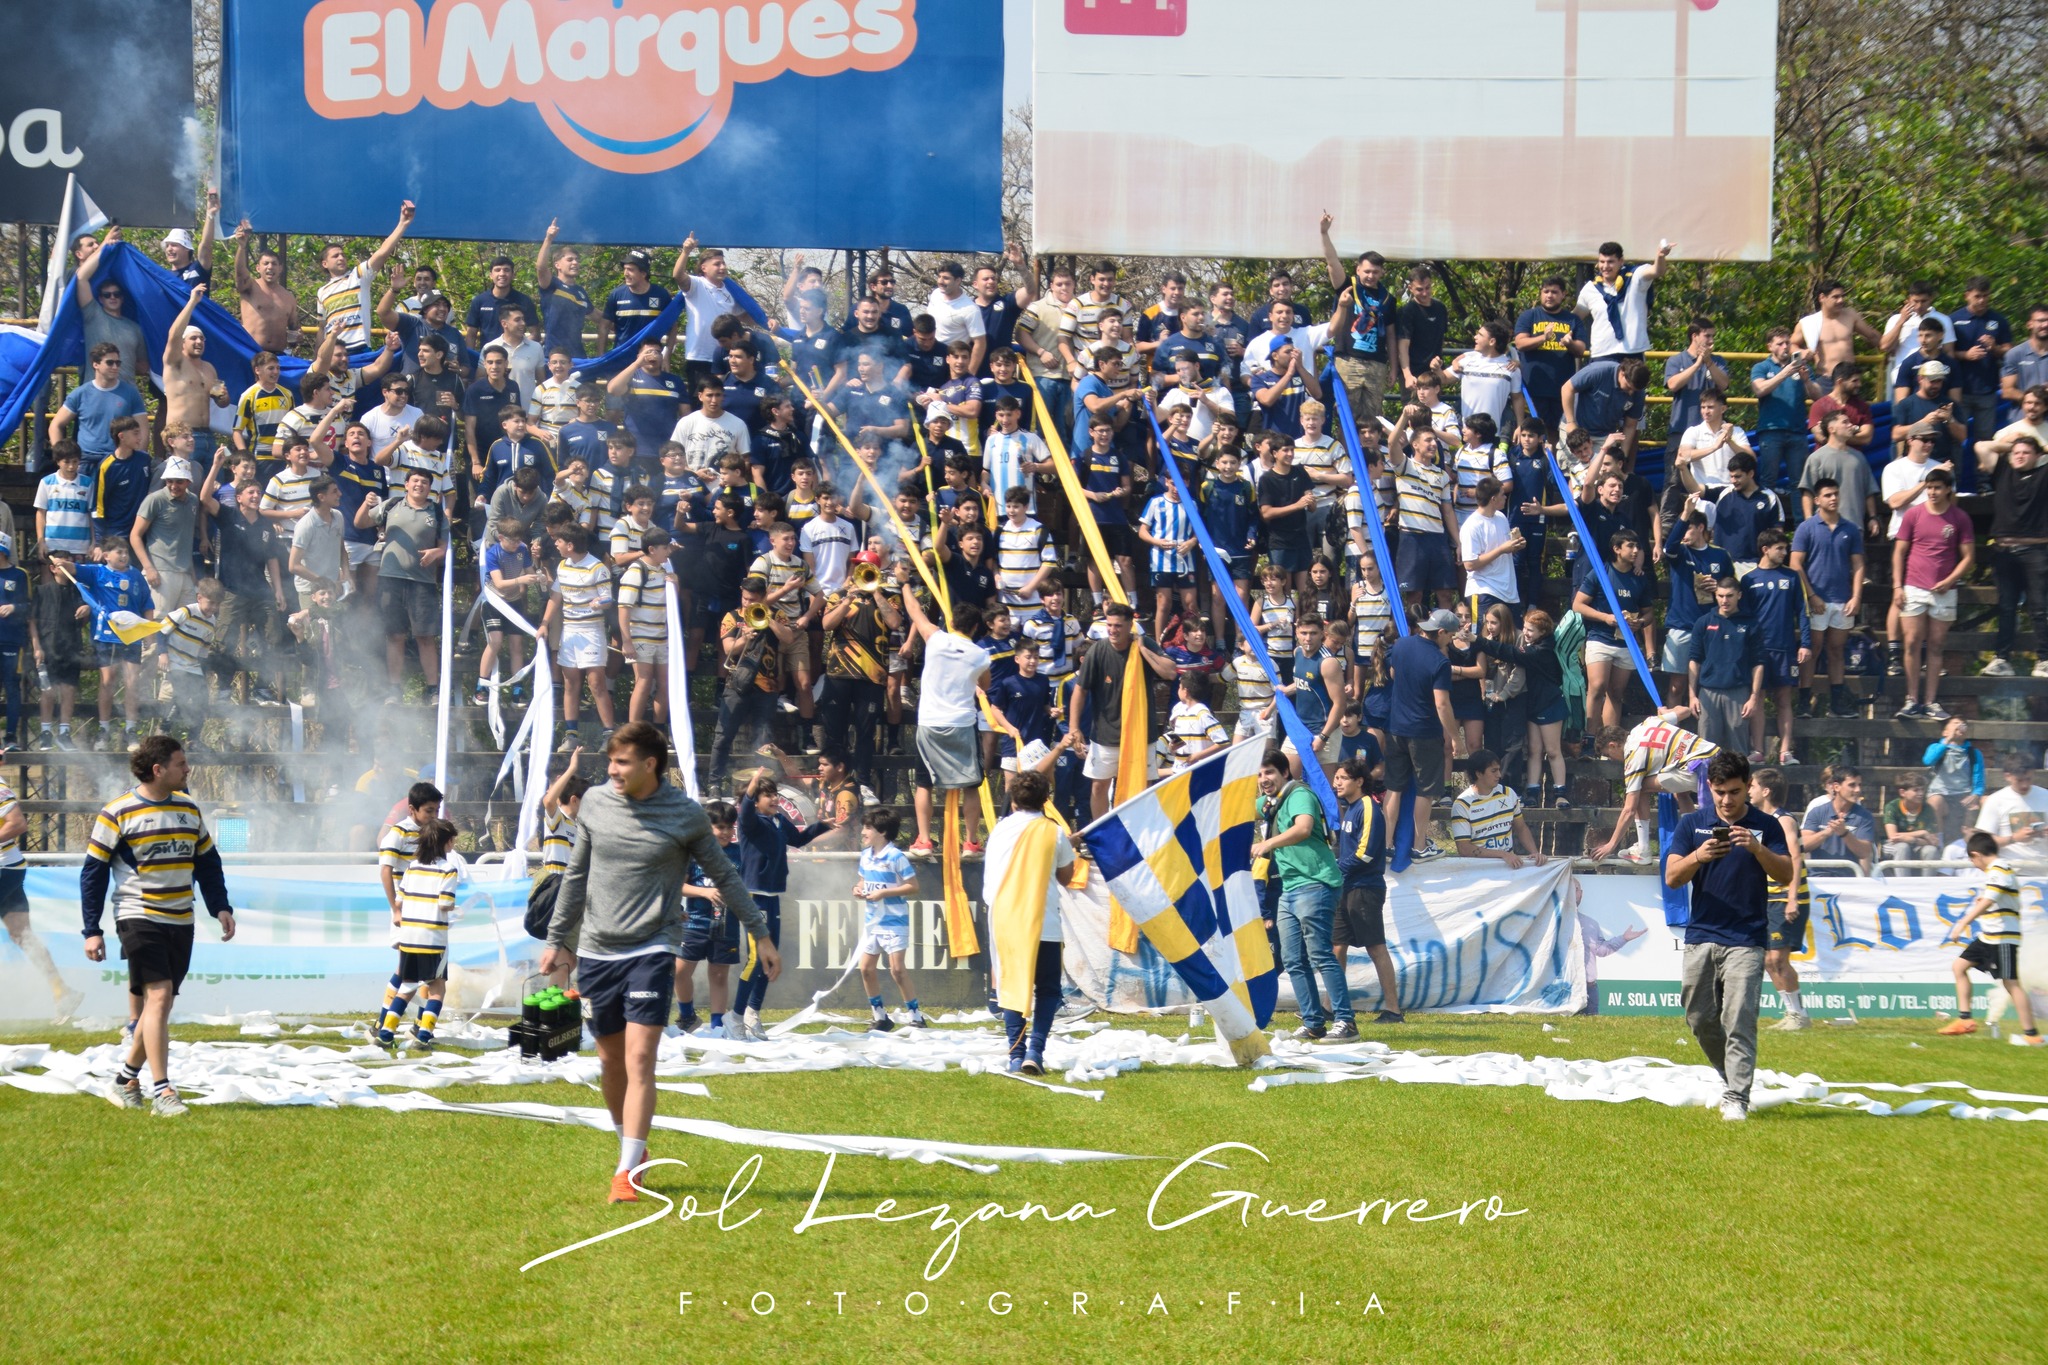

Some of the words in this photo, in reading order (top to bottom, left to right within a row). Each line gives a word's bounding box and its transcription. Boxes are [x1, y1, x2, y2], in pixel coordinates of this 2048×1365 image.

[322, 8, 411, 101] El
[437, 0, 904, 96] Marques
[1533, 321, 1570, 334] MICGAN
[57, 501, 81, 511] VISA
[1639, 726, 1671, 749] 13
[1485, 836, 1510, 849] Club
[866, 882, 887, 892] VISA
[794, 900, 977, 970] FEE
[1608, 992, 1625, 1006] AV.
[1628, 992, 1657, 1007] SOLA
[1659, 993, 1682, 1007] VER
[1759, 993, 1776, 1009] ZA
[1826, 995, 1846, 1009] 851
[547, 1026, 582, 1048] GILBERT
